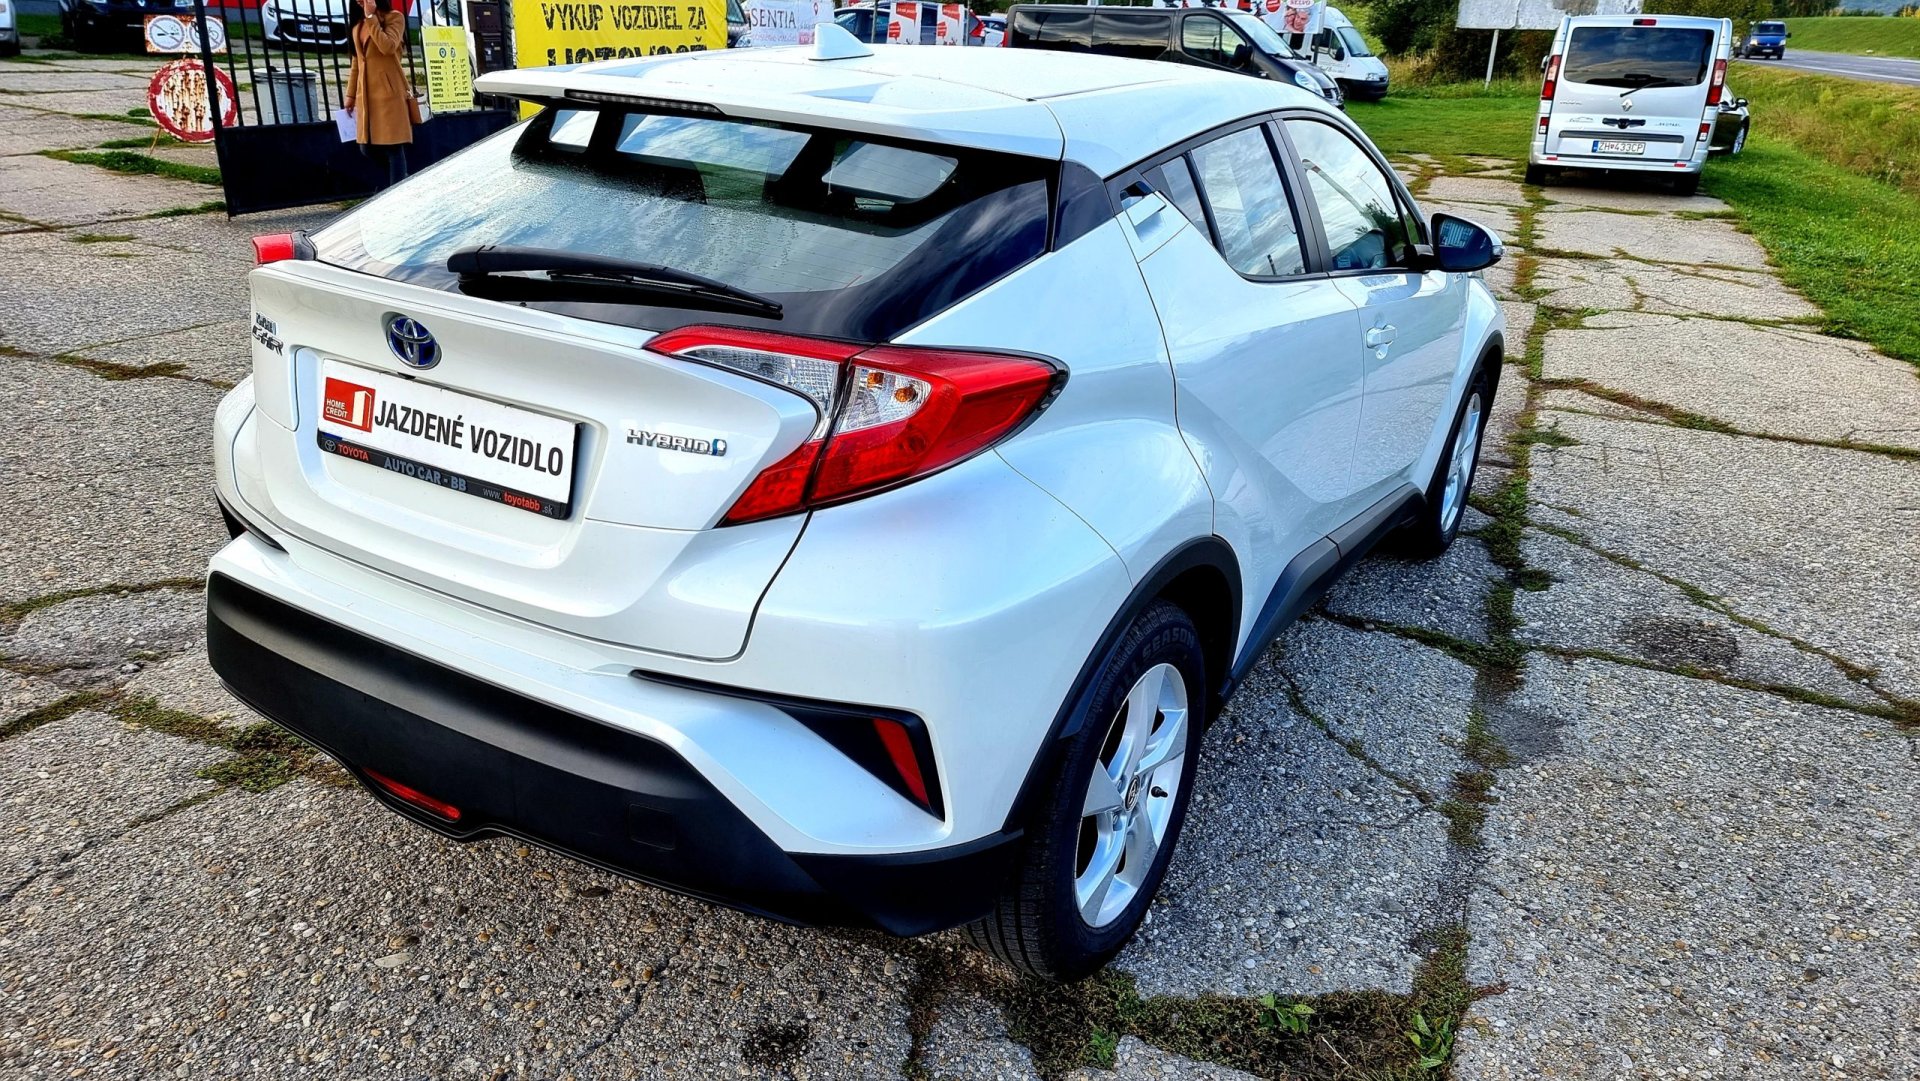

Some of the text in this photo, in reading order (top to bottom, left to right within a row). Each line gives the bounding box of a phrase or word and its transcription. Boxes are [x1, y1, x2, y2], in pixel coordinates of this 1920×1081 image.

[541, 3, 708, 31] VYKUP VOZIDIEL ZA
[325, 406, 348, 418] CREDIT
[326, 398, 346, 411] HOME
[337, 443, 369, 461] TOYOTA
[374, 400, 564, 477] JAZDENÉ VOZIDLO
[626, 428, 712, 456] HYBRID
[384, 456, 415, 477] AUTO
[417, 466, 442, 486] CAR
[450, 475, 467, 492] BB
